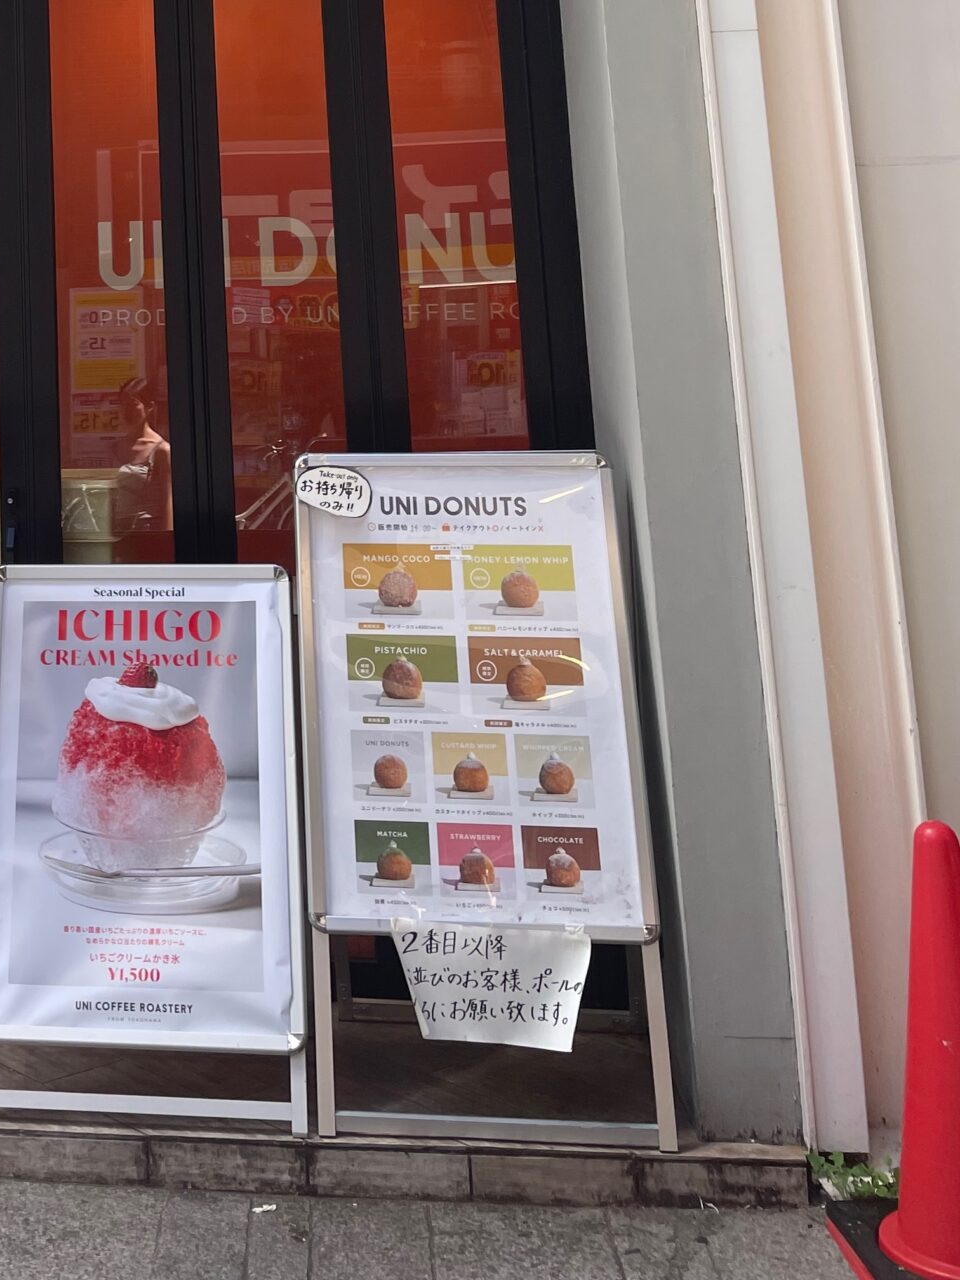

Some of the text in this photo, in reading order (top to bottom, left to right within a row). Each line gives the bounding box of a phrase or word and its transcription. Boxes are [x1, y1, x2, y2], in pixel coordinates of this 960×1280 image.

[261, 307, 294, 324] BY
[300, 479, 363, 500] お持ち帰り
[380, 496, 527, 517] UNI DONUTS
[363, 555, 400, 563] MANGO
[402, 555, 431, 563] COCO
[504, 556, 539, 564] LEMON
[542, 556, 569, 565] WHIP
[93, 586, 185, 599] Seasonal Special
[57, 609, 222, 642] ICHIGO
[374, 646, 427, 655] PISTACHIO
[40, 649, 238, 667] CREAM Shaved Ice
[377, 830, 408, 838] MATCHA
[449, 833, 501, 841] STRAWBERRY
[537, 836, 584, 844] CHOCOLATE
[401, 928, 508, 961] 2番目以降
[89, 952, 181, 965] いちごクリームかき氷
[108, 967, 161, 982] ¥1,500
[75, 1000, 193, 1014] UNI COFFEE ROASTERY
